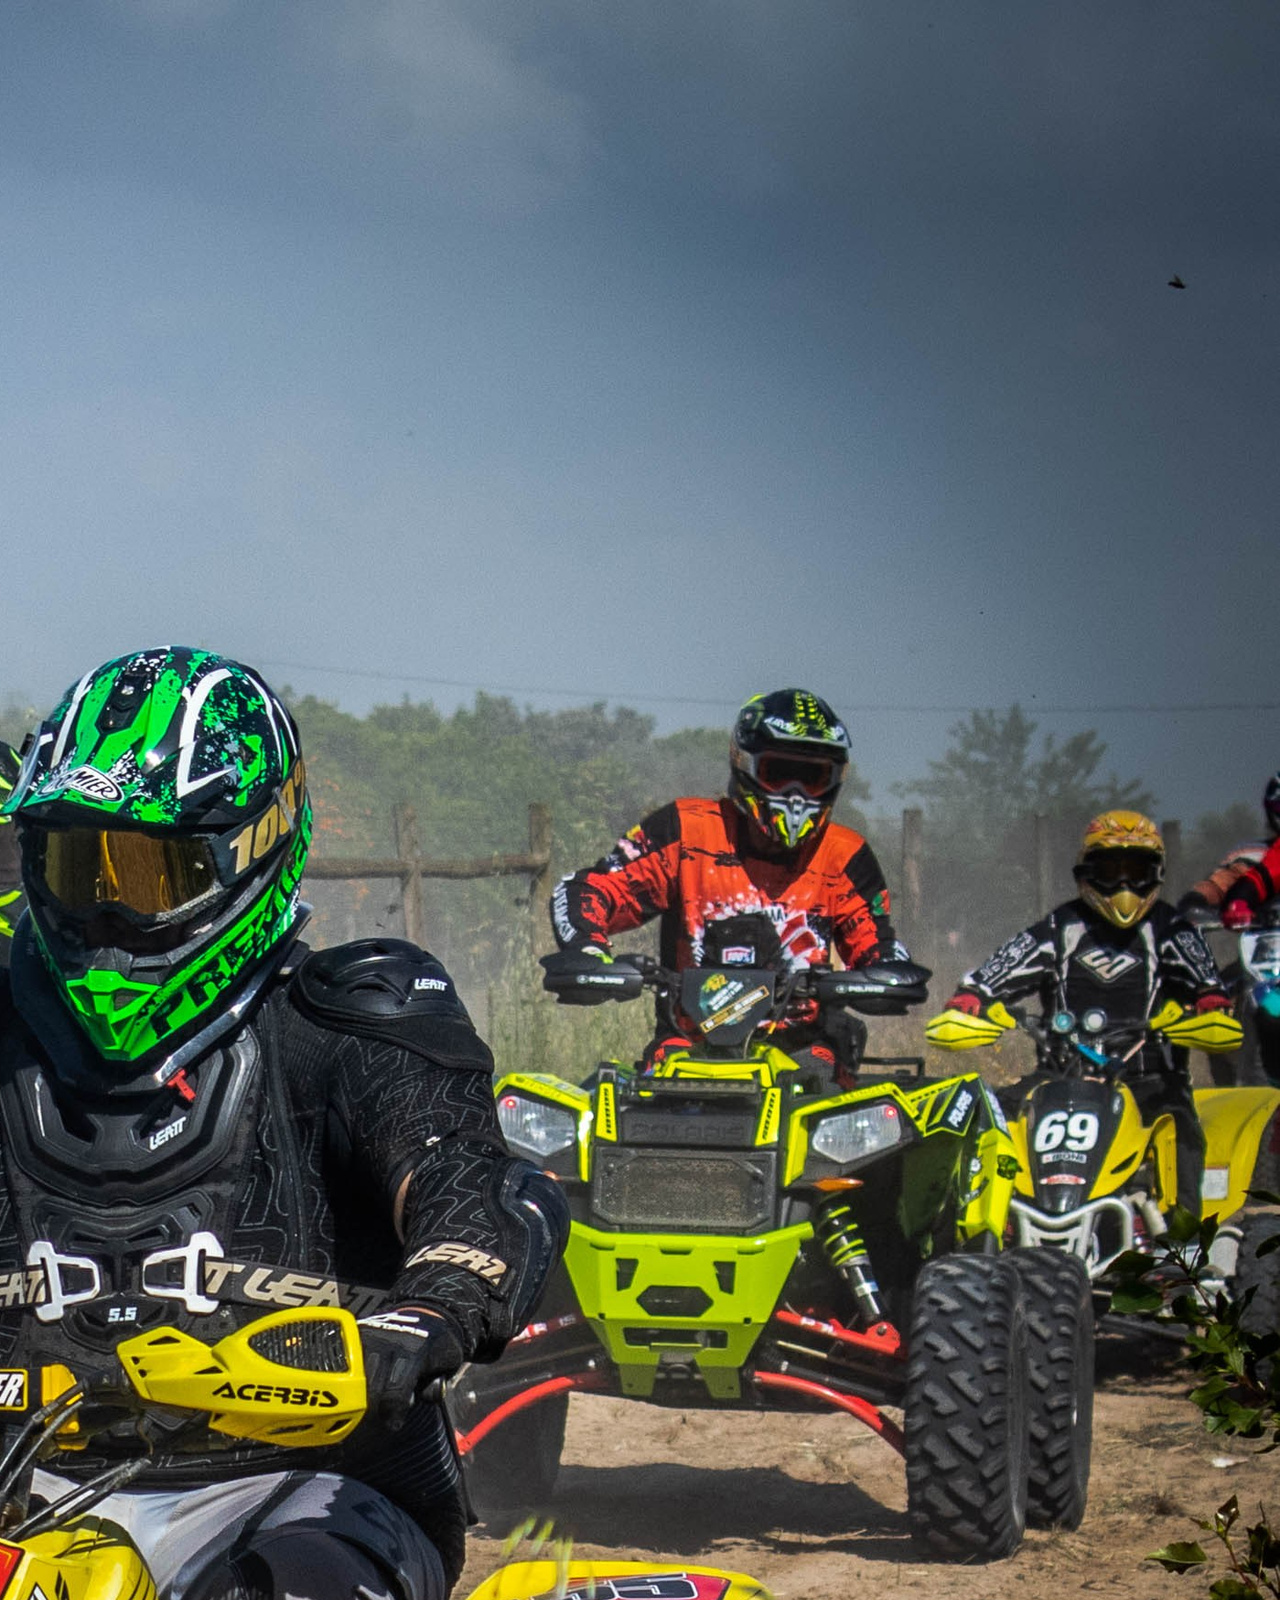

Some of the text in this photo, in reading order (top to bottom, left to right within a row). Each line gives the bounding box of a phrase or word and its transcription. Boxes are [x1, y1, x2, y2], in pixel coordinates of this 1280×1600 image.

[413, 977, 448, 992] LEATT
[149, 1116, 187, 1151] LEATT
[1034, 1111, 1099, 1152] 69
[108, 1306, 137, 1323] 5.5
[212, 1382, 339, 1408] ACERBIS
